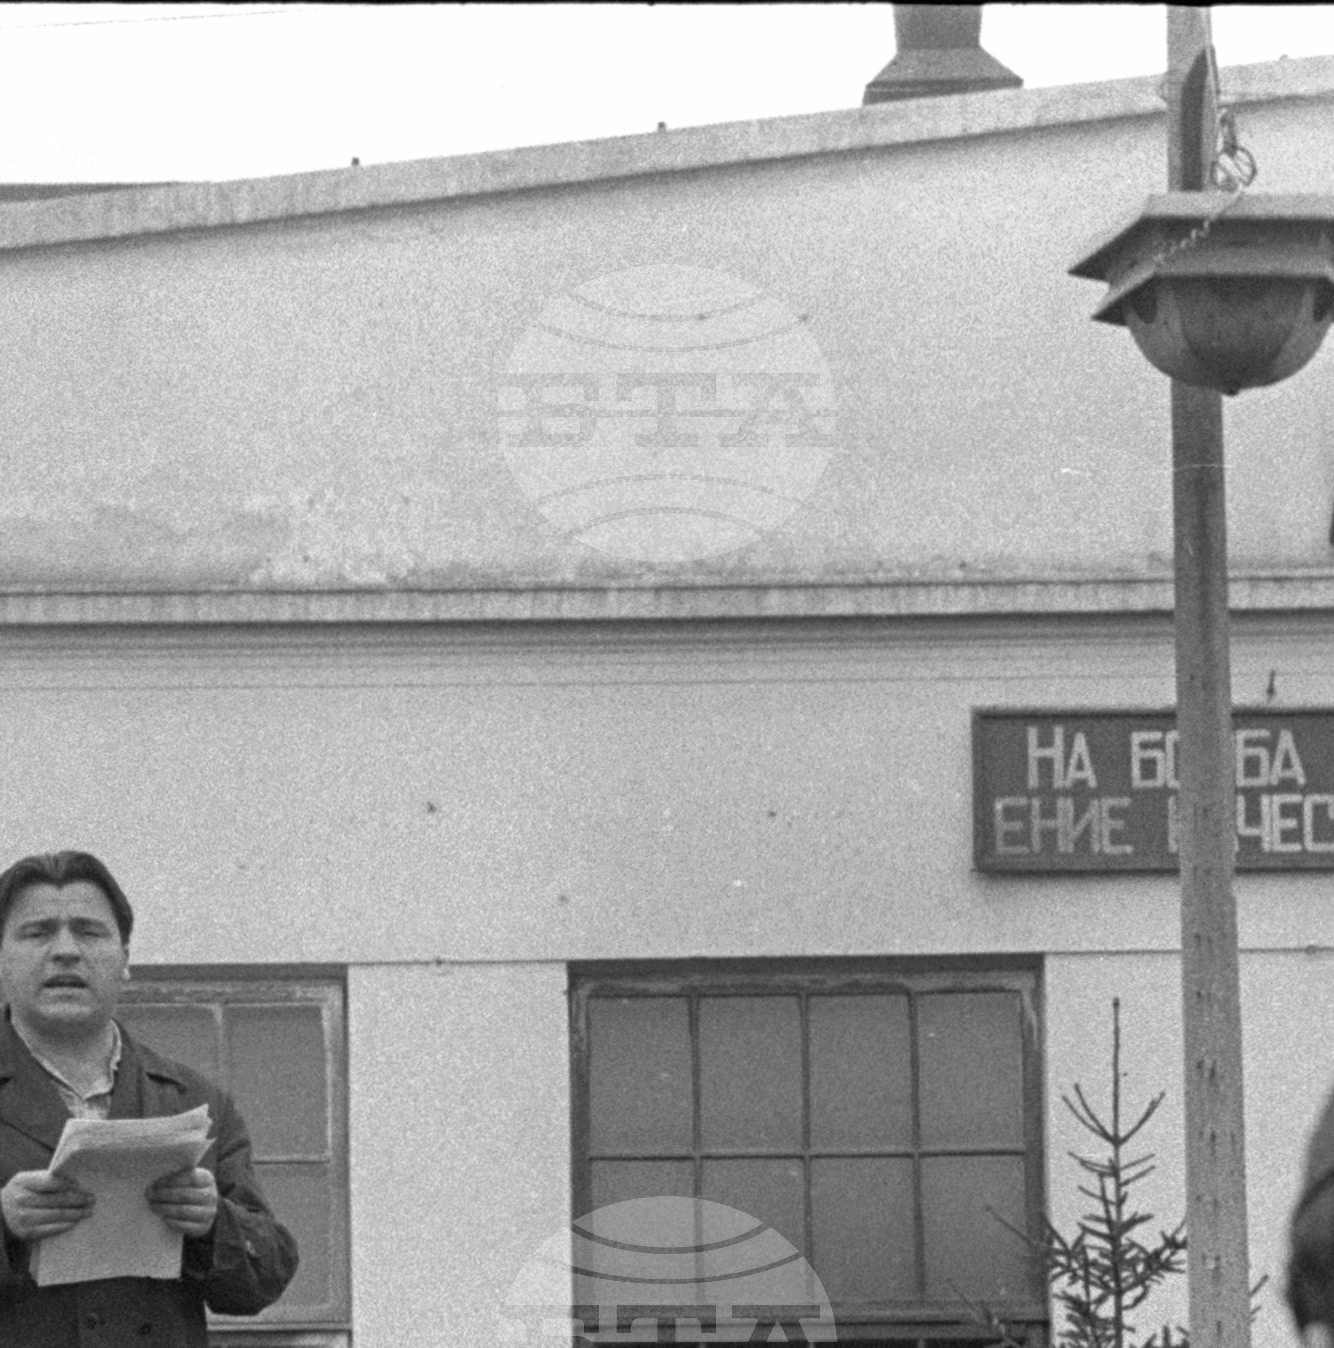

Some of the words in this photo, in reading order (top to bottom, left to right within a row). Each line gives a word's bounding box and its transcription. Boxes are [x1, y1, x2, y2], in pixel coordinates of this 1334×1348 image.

[1027, 725, 1097, 788] НА
[1131, 727, 1306, 788] ББА
[995, 796, 1133, 854] ЕНИЕ
